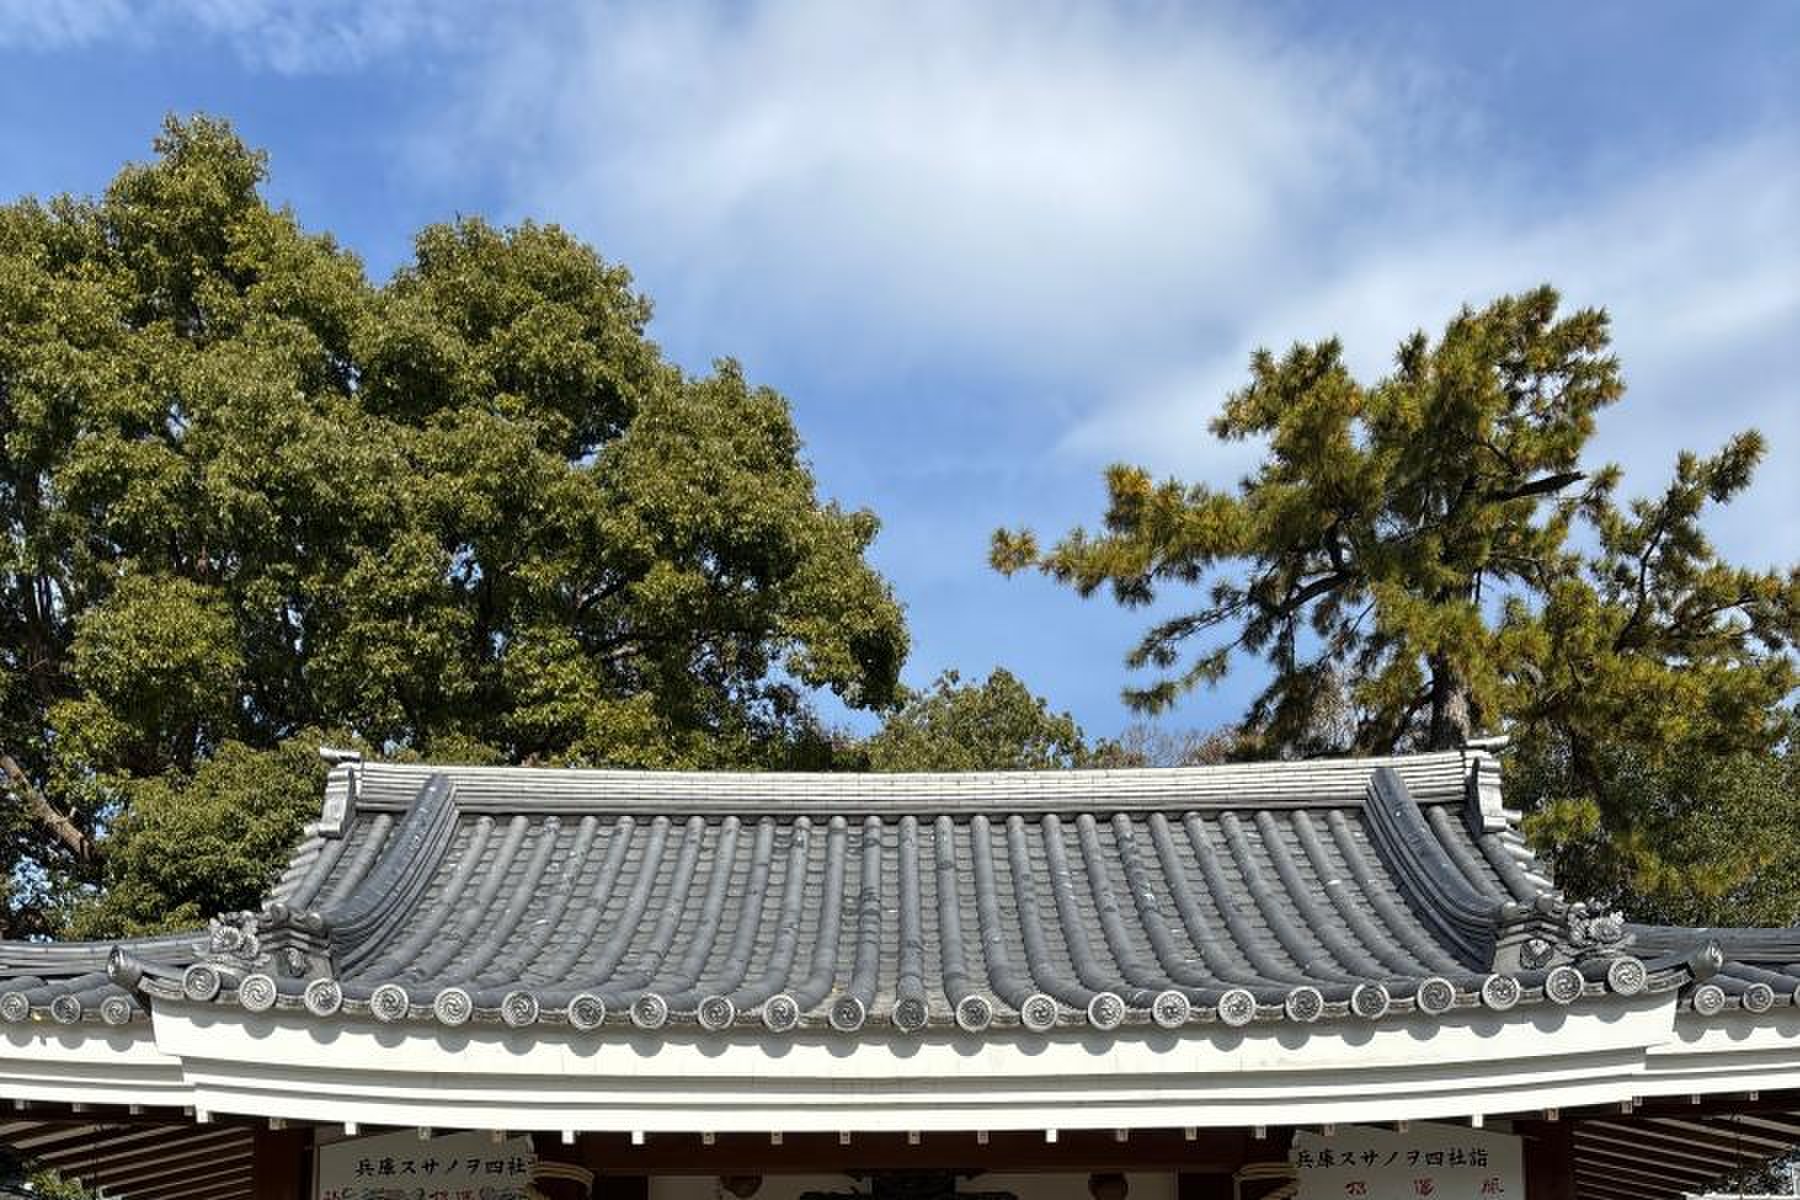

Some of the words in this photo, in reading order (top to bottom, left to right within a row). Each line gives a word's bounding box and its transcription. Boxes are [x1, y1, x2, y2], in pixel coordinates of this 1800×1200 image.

[354, 1157, 532, 1177] 兵庫スサノヲ四社
[1296, 1148, 1489, 1168] 兵庫スサノヲ四社詣
